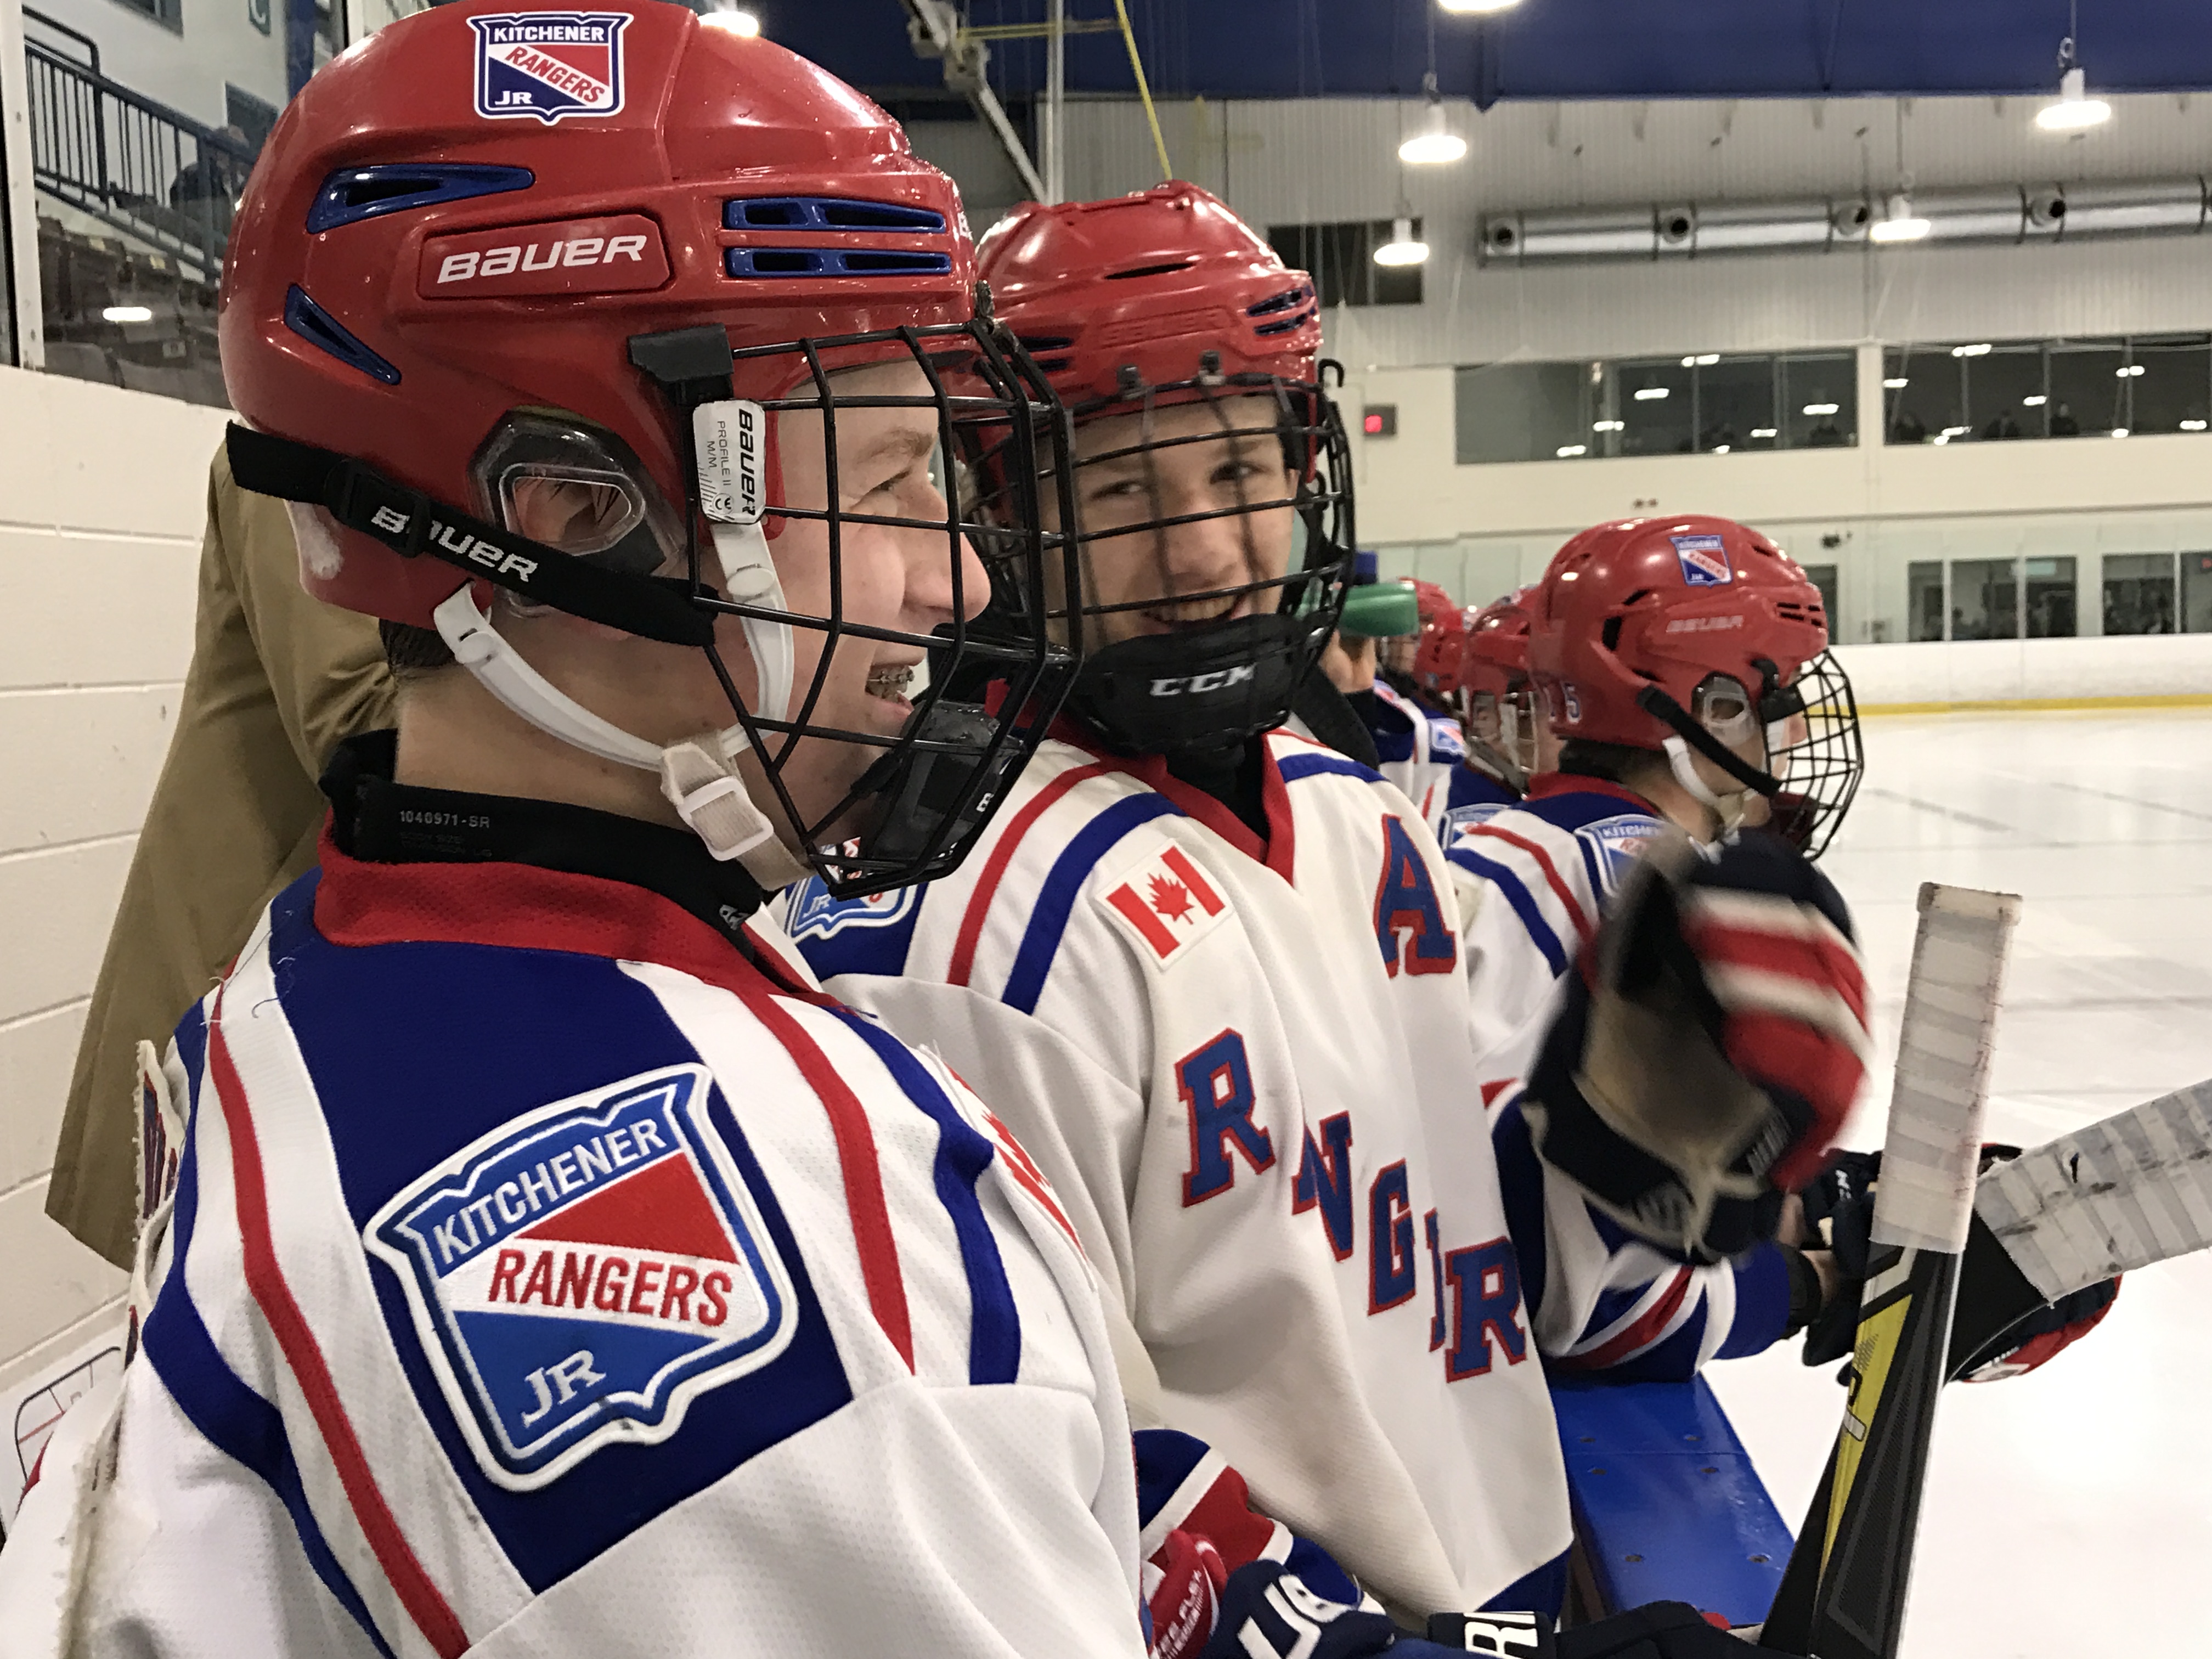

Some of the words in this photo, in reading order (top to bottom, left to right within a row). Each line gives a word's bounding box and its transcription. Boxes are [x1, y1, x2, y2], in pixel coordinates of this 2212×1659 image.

[493, 26, 605, 42] KITCHENER
[495, 91, 533, 105] JR
[504, 46, 605, 104] RANGERS
[437, 235, 647, 284] BAUER
[707, 441, 718, 468] M/M
[717, 421, 731, 476] PROFILE
[738, 408, 756, 516] BAUER
[371, 505, 539, 583] BUER
[1150, 662, 1260, 696] CCM
[399, 810, 490, 828] 1040971-SR
[1373, 814, 1457, 979] A
[433, 1118, 667, 1265] KITCHENER
[488, 1248, 732, 1328] RANGERS
[521, 1350, 607, 1428] JR
